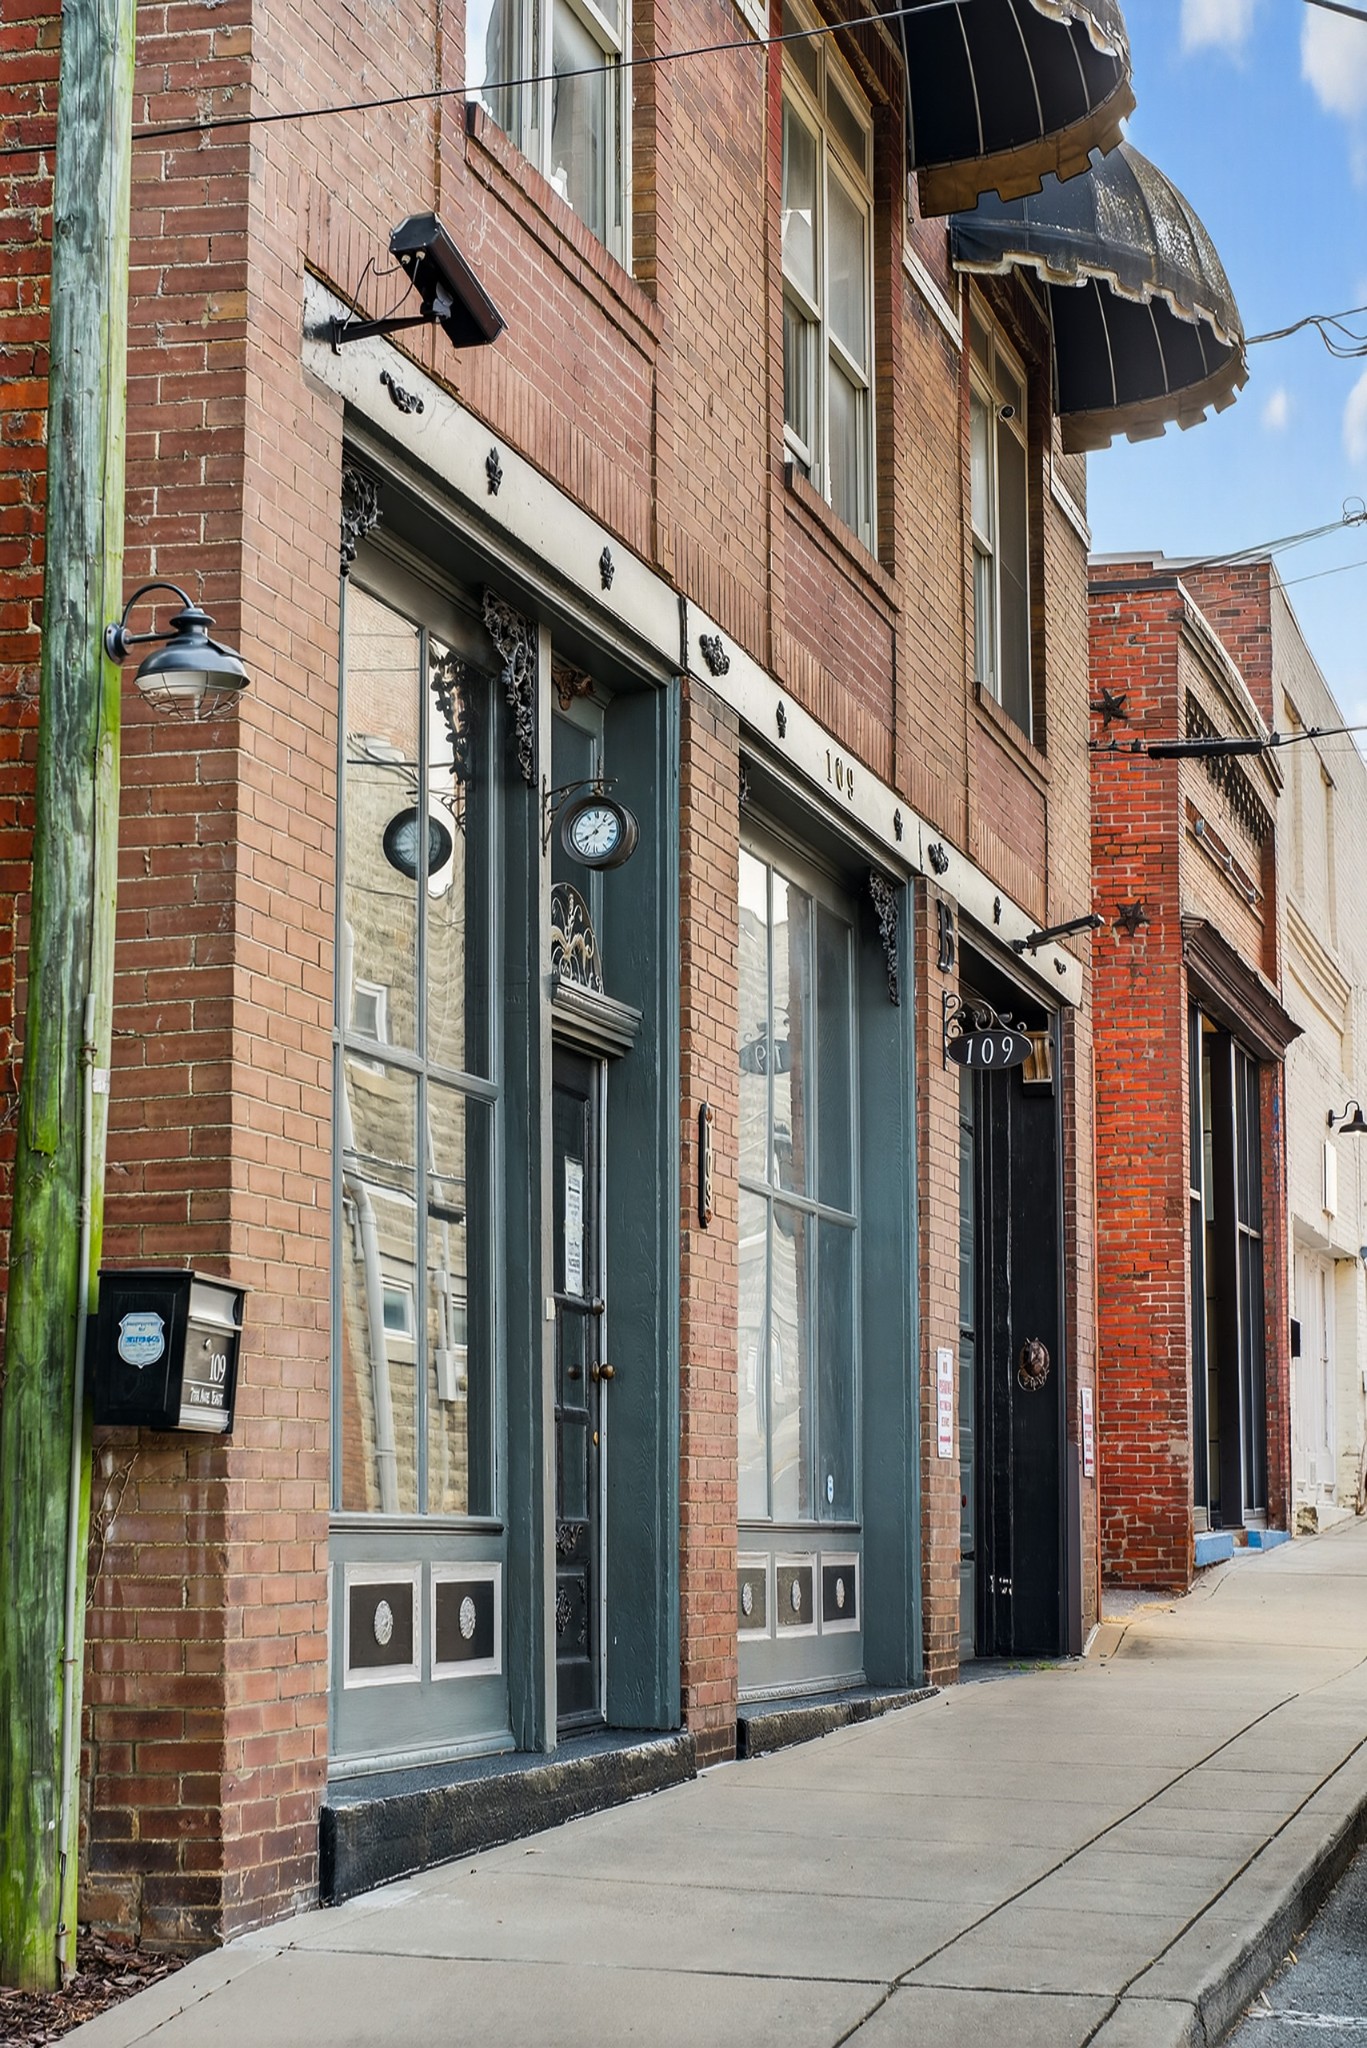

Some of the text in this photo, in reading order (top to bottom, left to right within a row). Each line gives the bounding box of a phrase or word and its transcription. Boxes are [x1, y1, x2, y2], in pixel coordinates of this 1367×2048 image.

[826, 749, 854, 801] 109
[966, 1036, 1014, 1065] 109
[209, 1353, 226, 1383] 109
